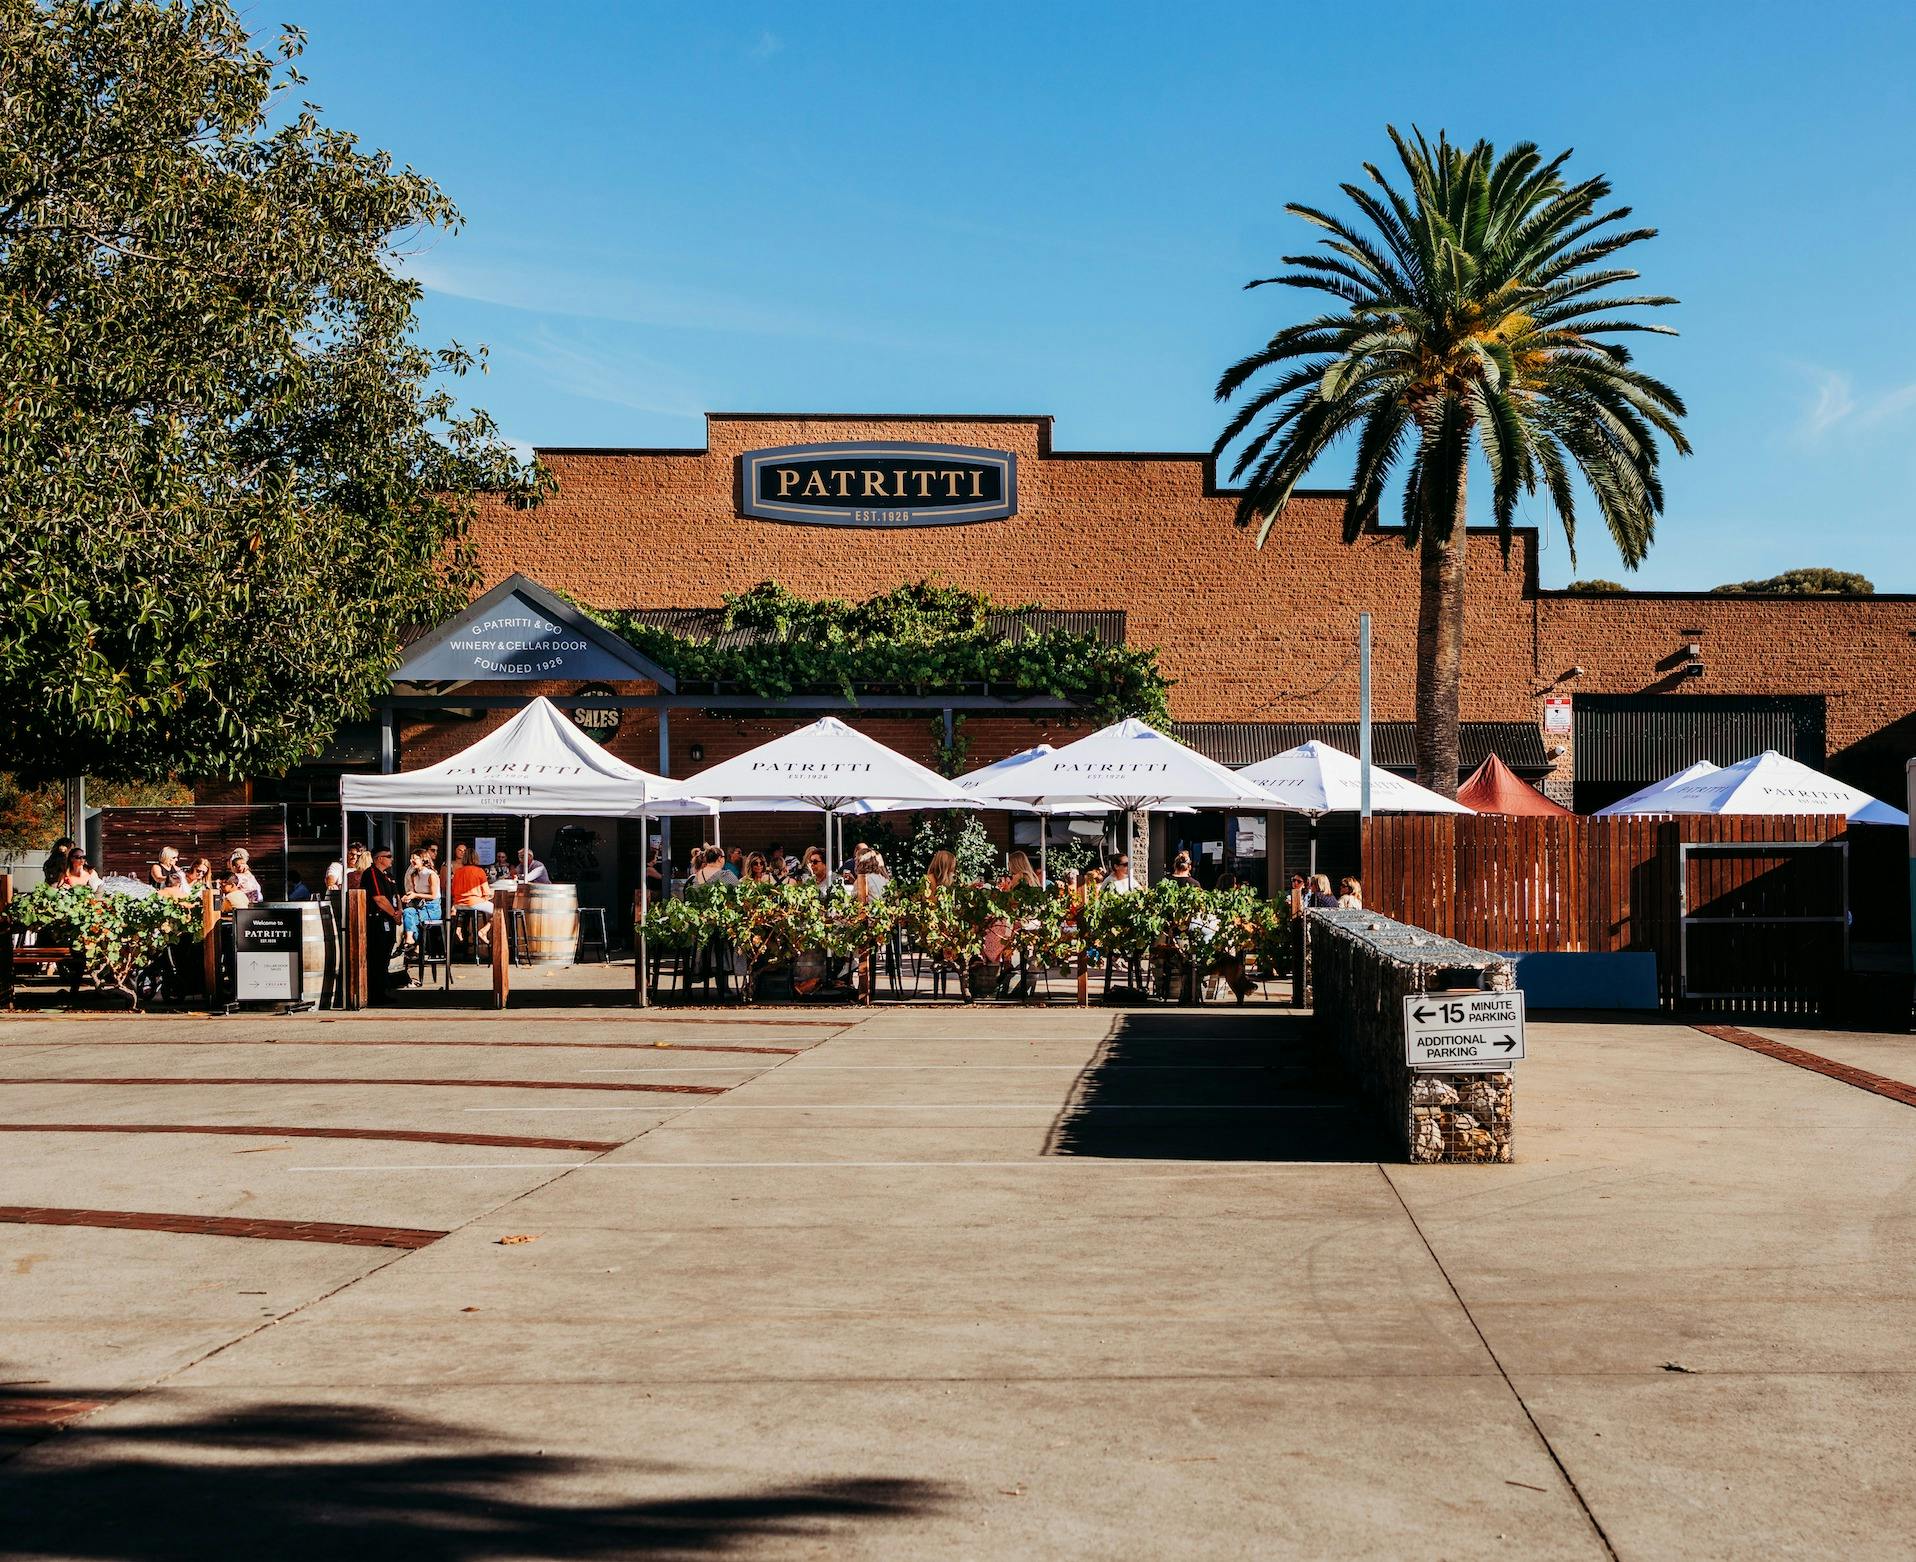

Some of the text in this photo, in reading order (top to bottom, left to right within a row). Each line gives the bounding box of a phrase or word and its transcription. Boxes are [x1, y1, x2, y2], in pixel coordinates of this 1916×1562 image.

[776, 469, 984, 497] PATRITTI
[855, 511, 909, 521] EST.1926
[534, 620, 541, 629] &
[544, 622, 563, 635] CO
[552, 641, 587, 651] DOOR
[474, 656, 563, 673] FOUNDED 1926
[574, 708, 619, 728] SALES
[446, 763, 581, 775] PATRITTI
[752, 762, 871, 772] PATRITTI
[1053, 763, 1168, 772] PATRITTI
[456, 784, 531, 796] PATRITTI
[1763, 786, 1850, 801] PATRITTI
[1439, 1000, 1513, 1023] 15 MINUTE
[1469, 1011, 1516, 1022] PARKING
[1417, 1034, 1487, 1047] ADDITIONAL
[1427, 1046, 1478, 1058] PARKING
